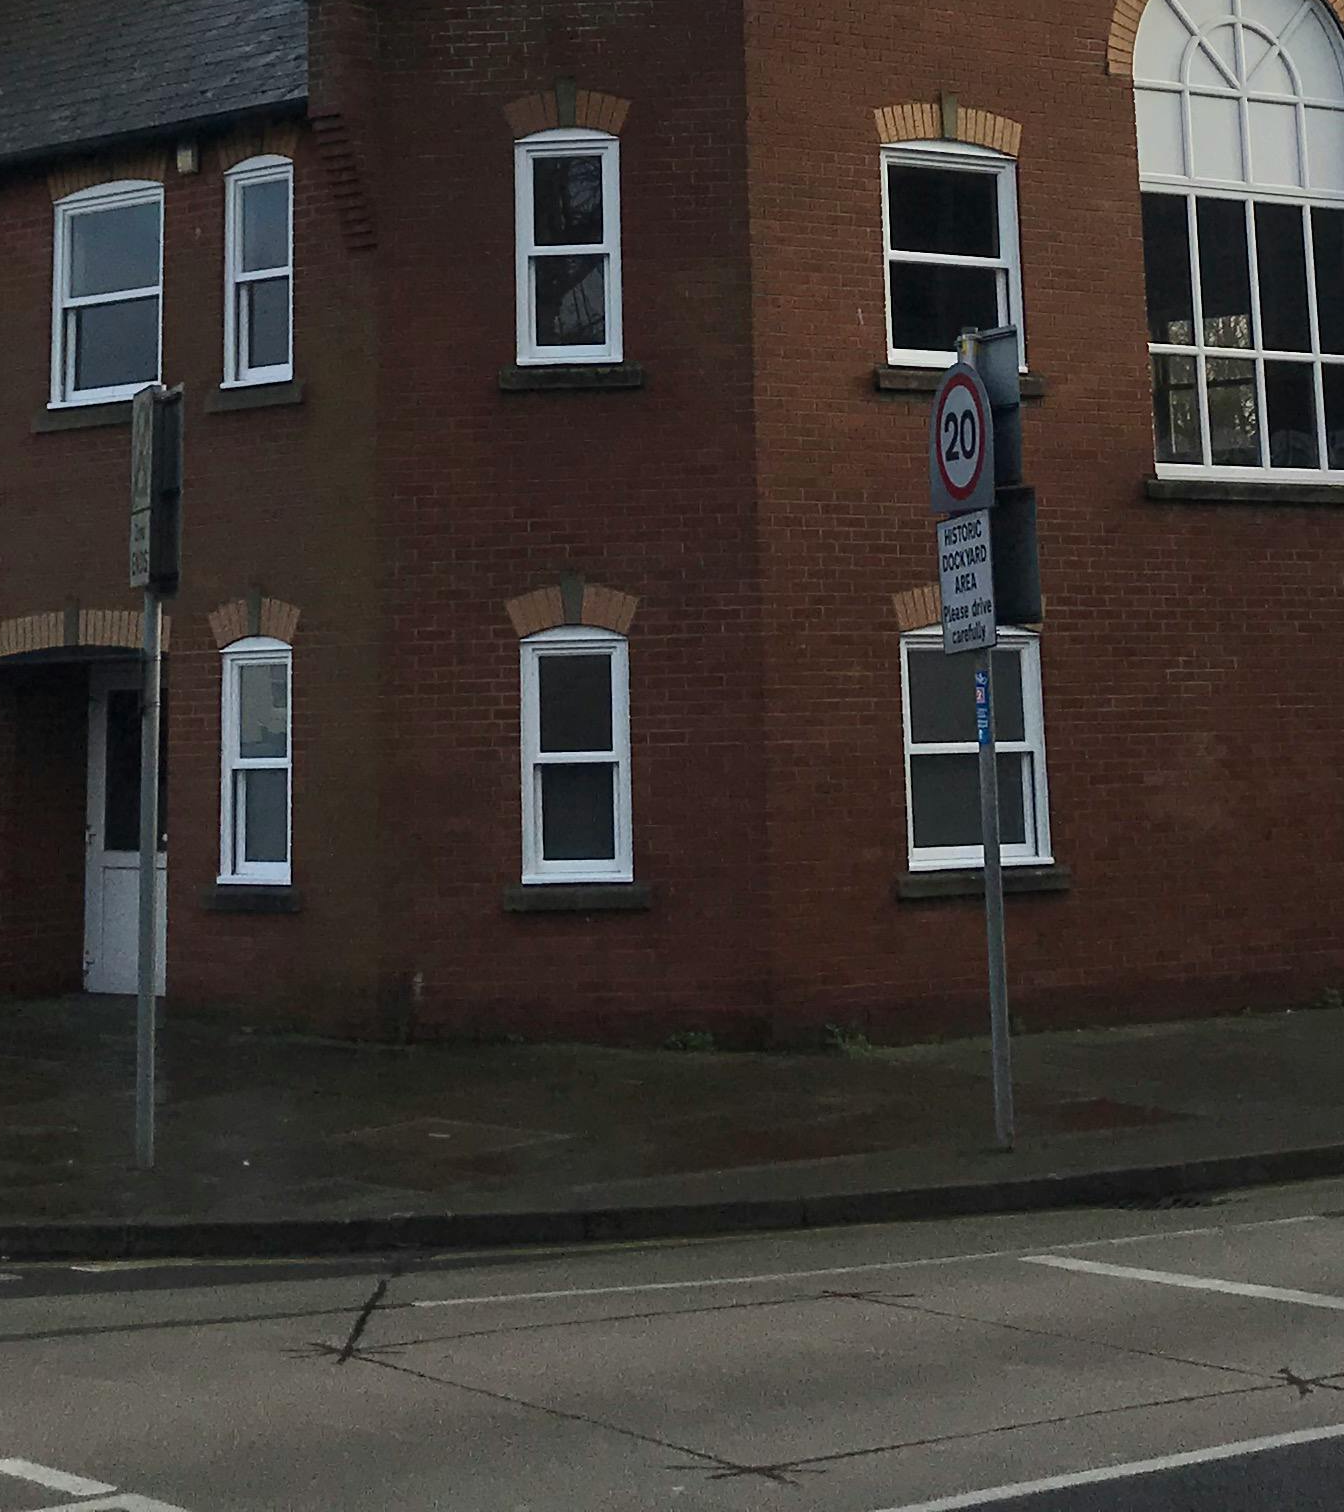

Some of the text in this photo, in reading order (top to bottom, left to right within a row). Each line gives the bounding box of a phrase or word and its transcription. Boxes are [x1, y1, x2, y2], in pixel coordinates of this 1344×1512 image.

[944, 409, 976, 462] 20
[944, 519, 983, 546] HISTORIC
[942, 544, 987, 573] DOCKYARD
[955, 572, 977, 595] AREA
[944, 596, 992, 625] Please drive
[952, 620, 986, 644] carefully
